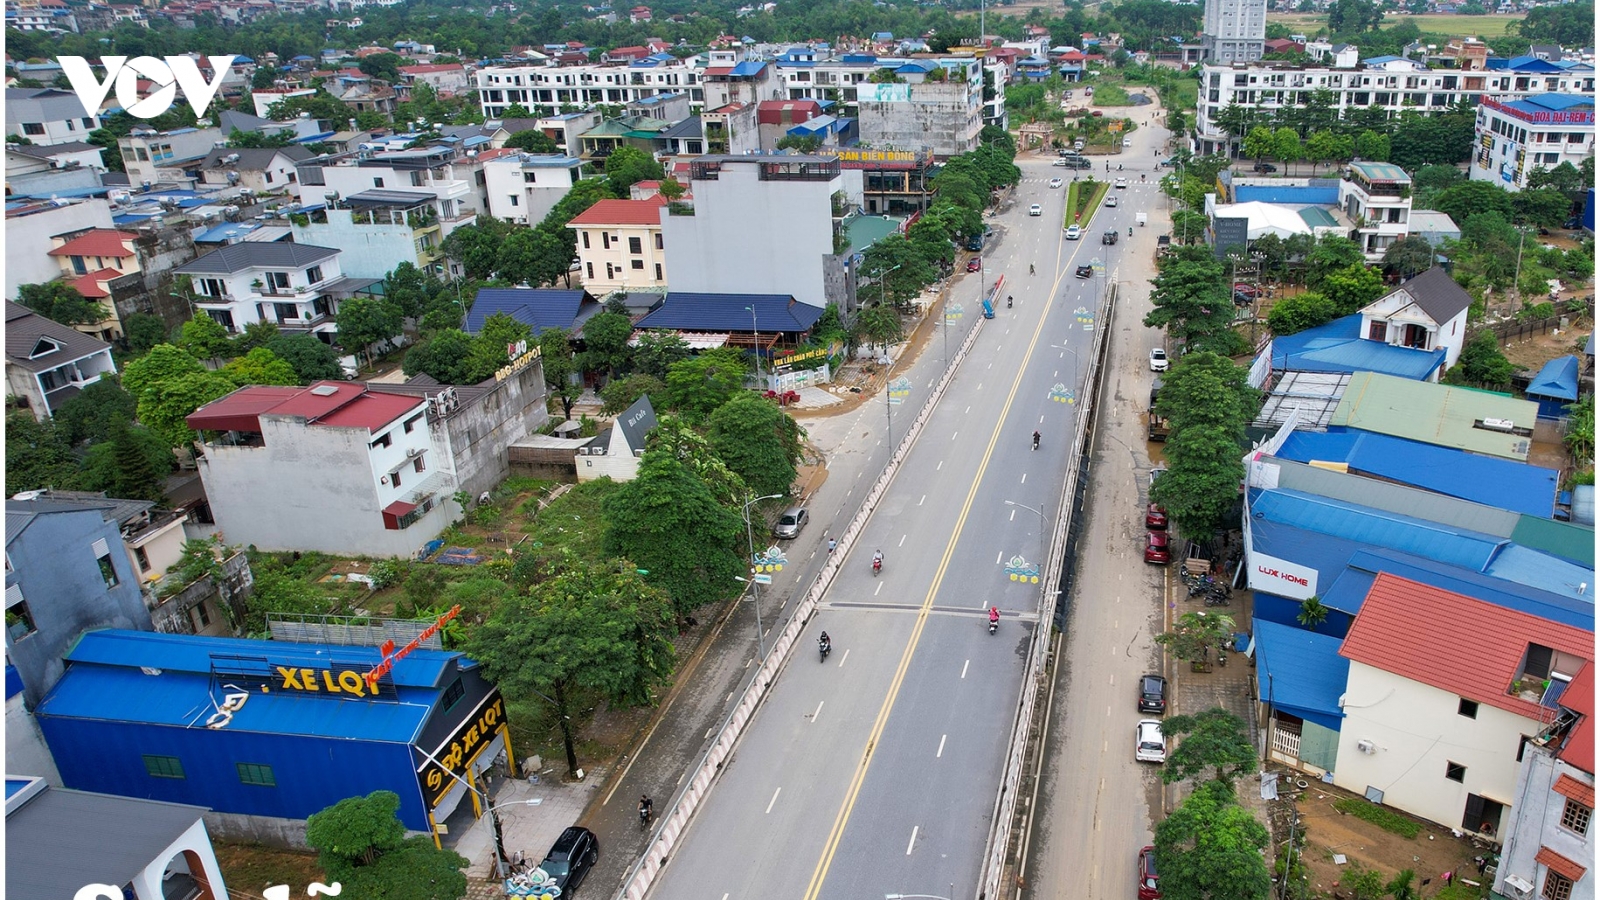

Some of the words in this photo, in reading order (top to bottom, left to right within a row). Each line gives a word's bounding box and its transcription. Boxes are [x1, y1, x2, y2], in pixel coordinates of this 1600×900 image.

[1534, 111, 1550, 123] HOA
[1281, 572, 1308, 587] HOME
[276, 666, 320, 691] XE
[322, 670, 380, 698] LQT
[462, 724, 480, 753] XE
[479, 699, 502, 735] LQT
